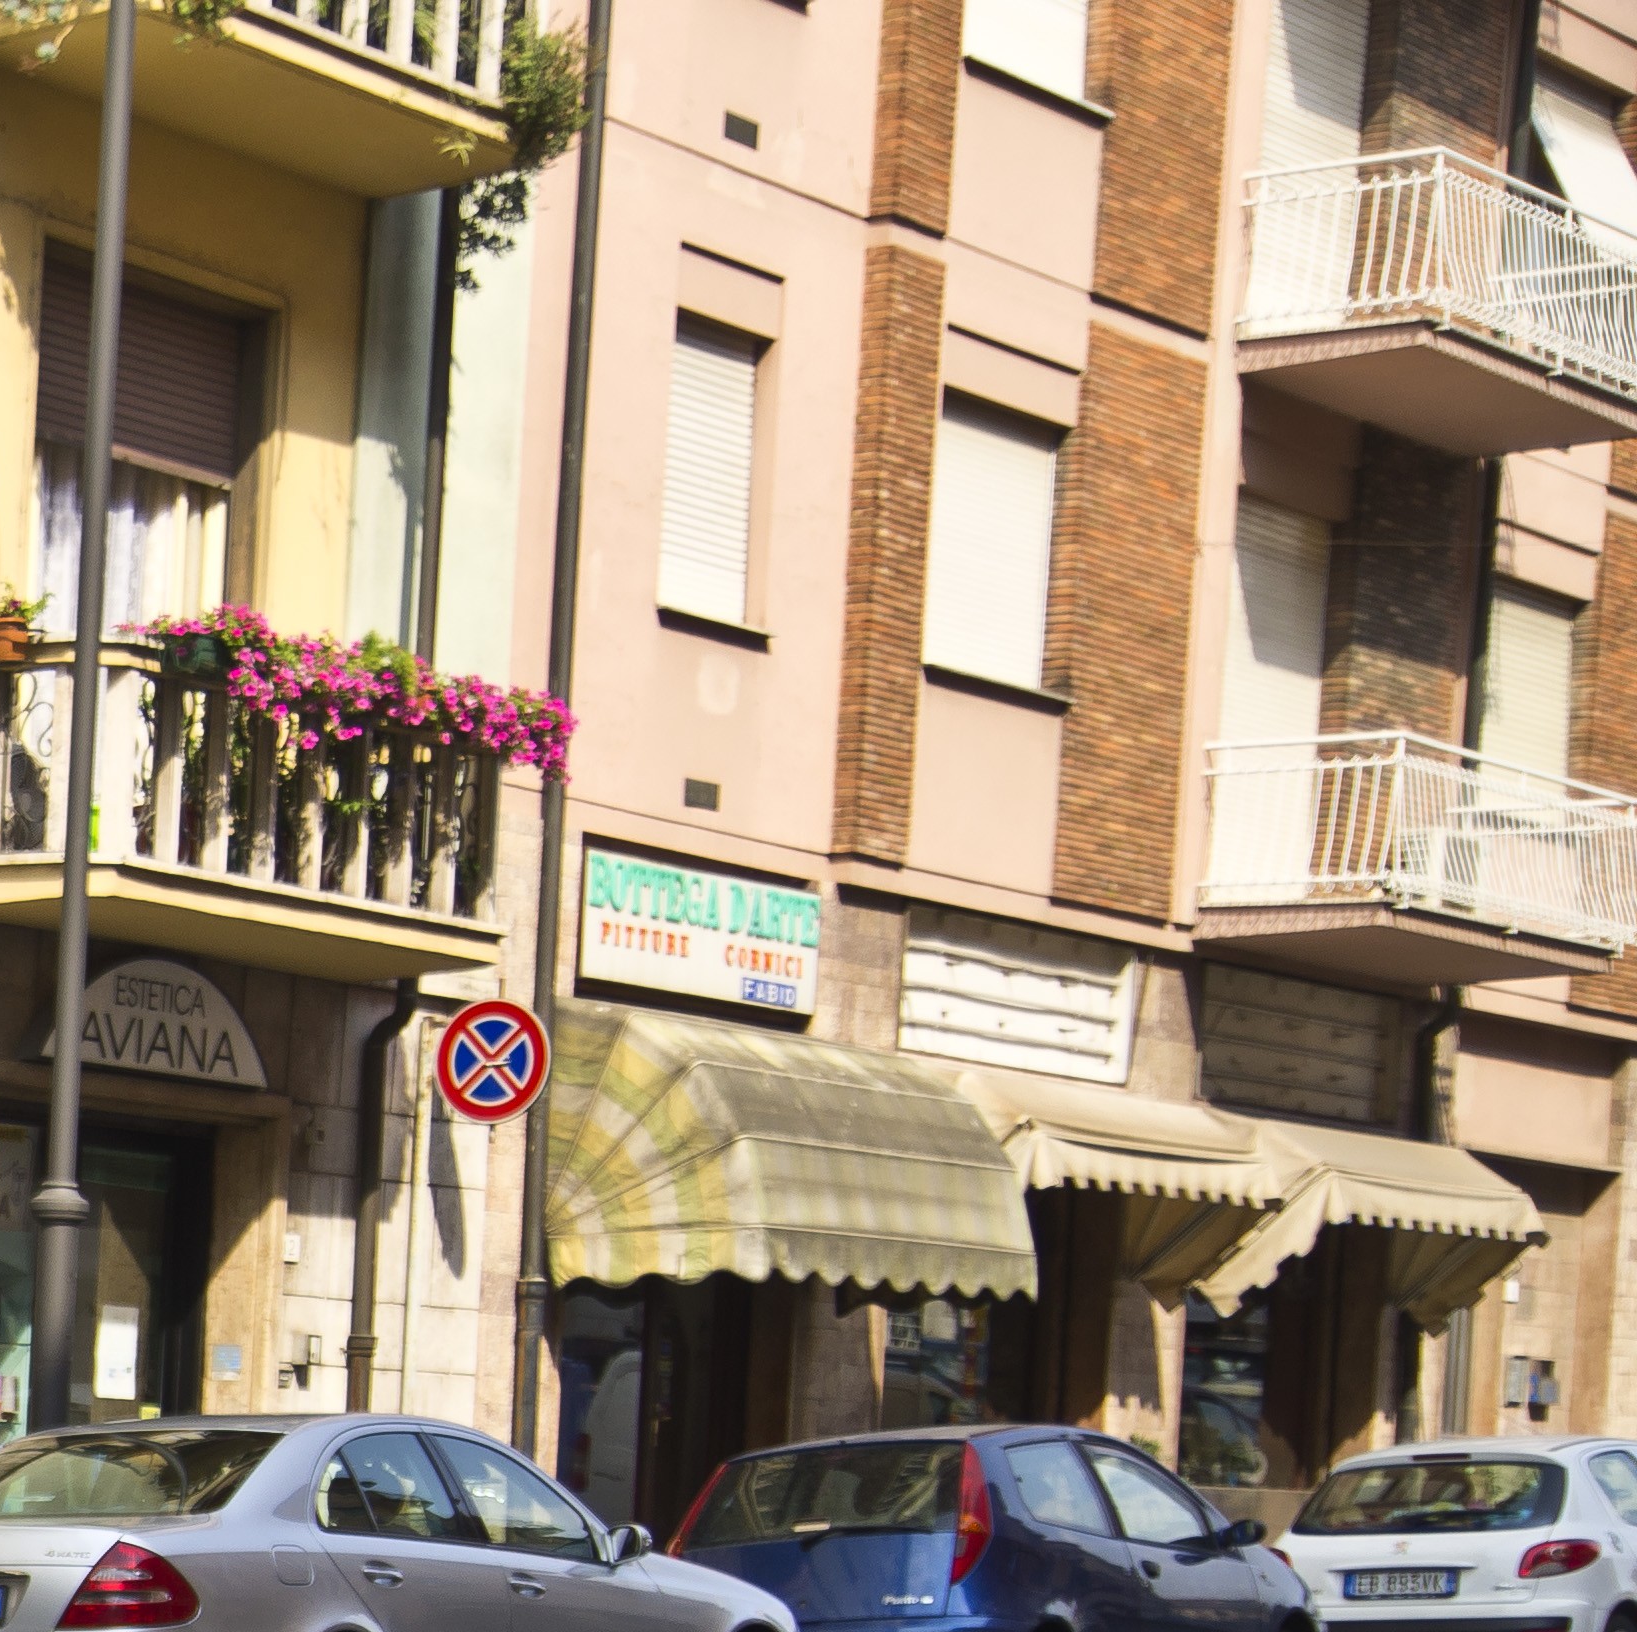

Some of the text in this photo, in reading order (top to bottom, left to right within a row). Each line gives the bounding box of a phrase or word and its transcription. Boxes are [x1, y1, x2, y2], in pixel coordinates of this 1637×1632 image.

[589, 853, 820, 948] BOTTEGA D'ARTE
[600, 921, 803, 979] PITTURE CORNICI
[115, 975, 206, 1018] ESTETICA
[80, 1012, 240, 1077] AVIANA
